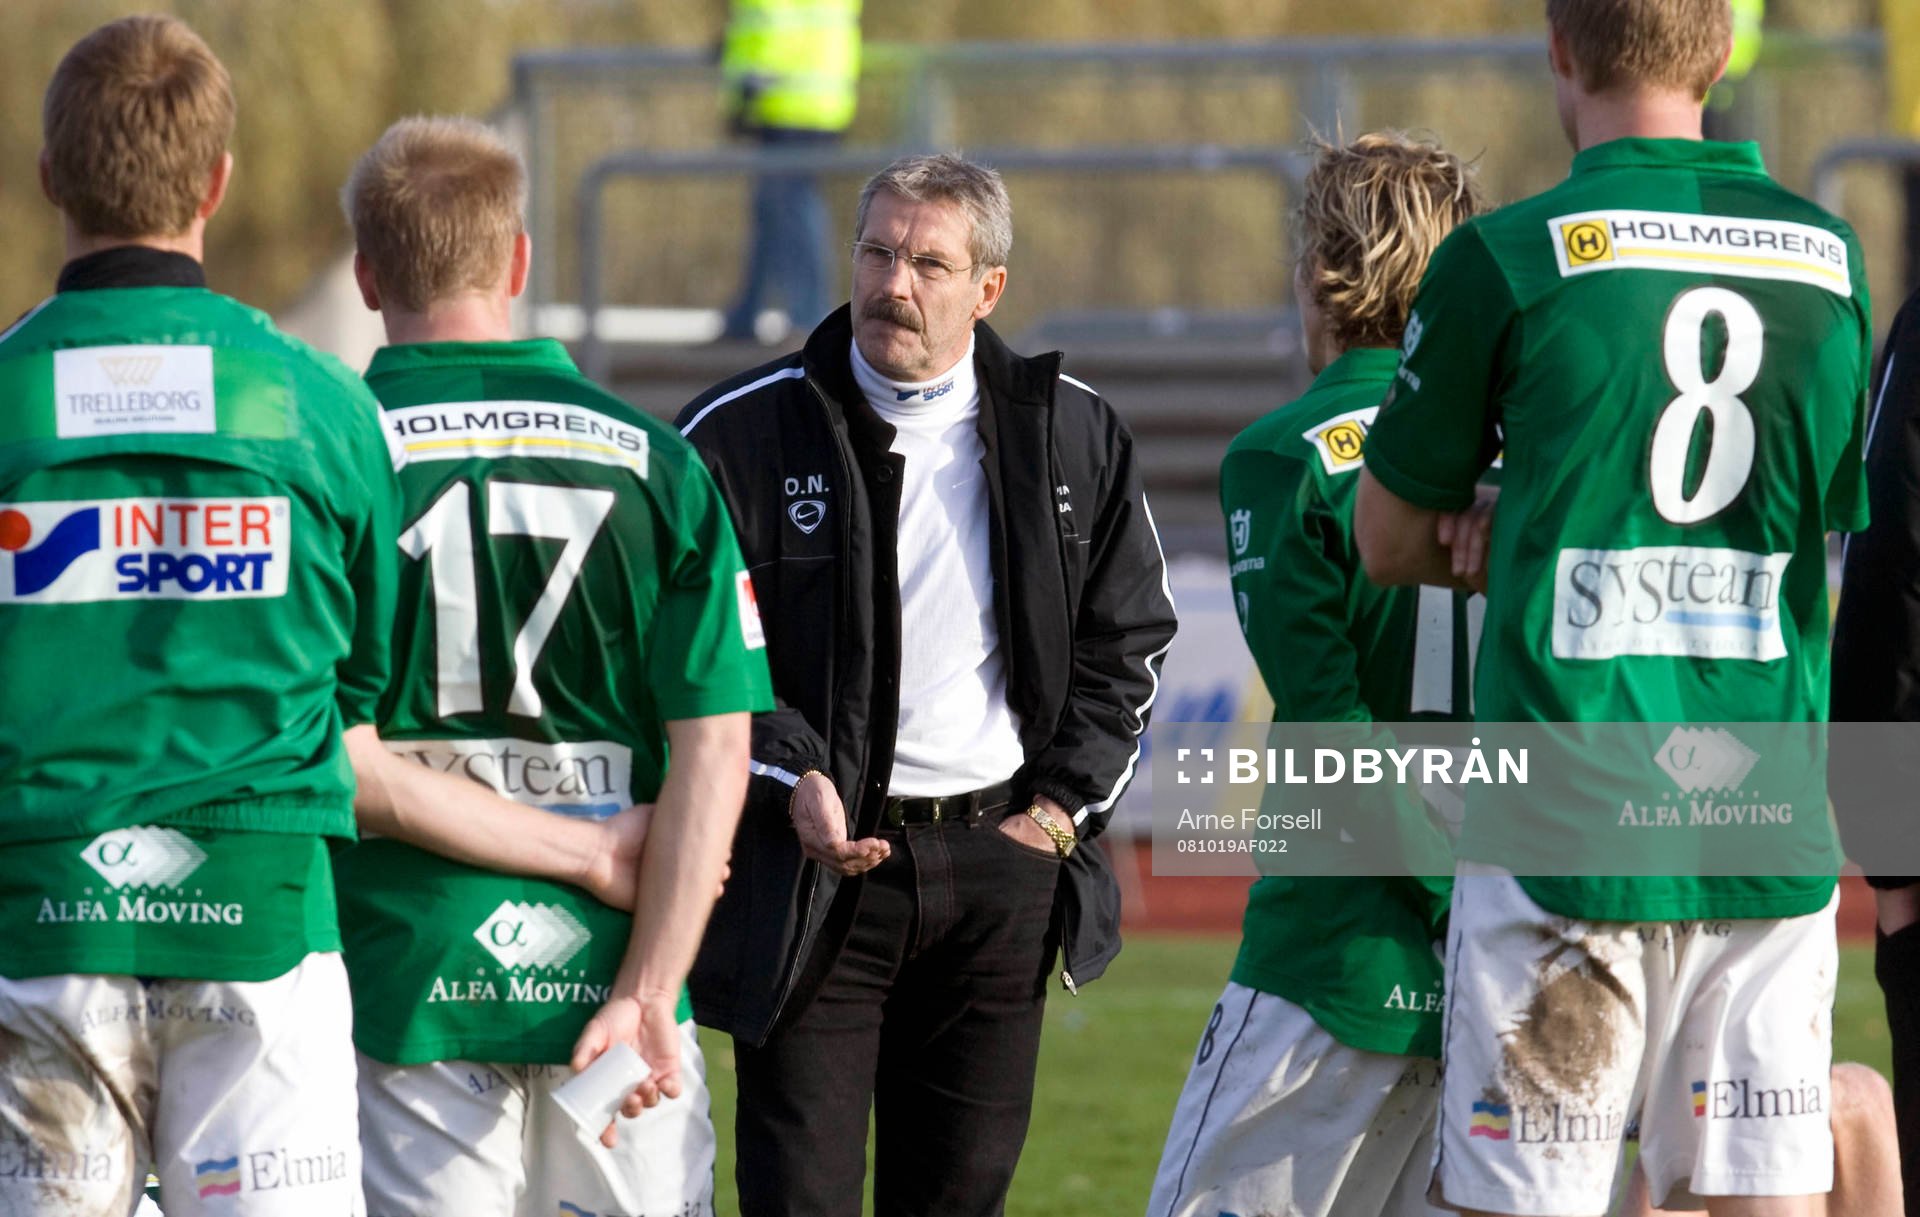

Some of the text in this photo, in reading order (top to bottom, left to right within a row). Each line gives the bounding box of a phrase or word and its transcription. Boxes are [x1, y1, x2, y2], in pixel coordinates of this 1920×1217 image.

[1611, 220, 1842, 265] HOLMGRENS
[66, 389, 201, 414] TRELLEBORG
[1650, 286, 1763, 524] 8
[785, 474, 829, 496] O.N.
[115, 504, 271, 546] INTER
[115, 552, 272, 593] SPORT
[397, 481, 616, 718] 17
[1617, 800, 1793, 826] ALFA MOVING
[37, 896, 243, 925] ALFA MOVING
[427, 976, 498, 1002] ALFA
[1712, 1078, 1822, 1119] Elmia
[1518, 1103, 1622, 1143] Elmia
[247, 1147, 346, 1191] Elmia
